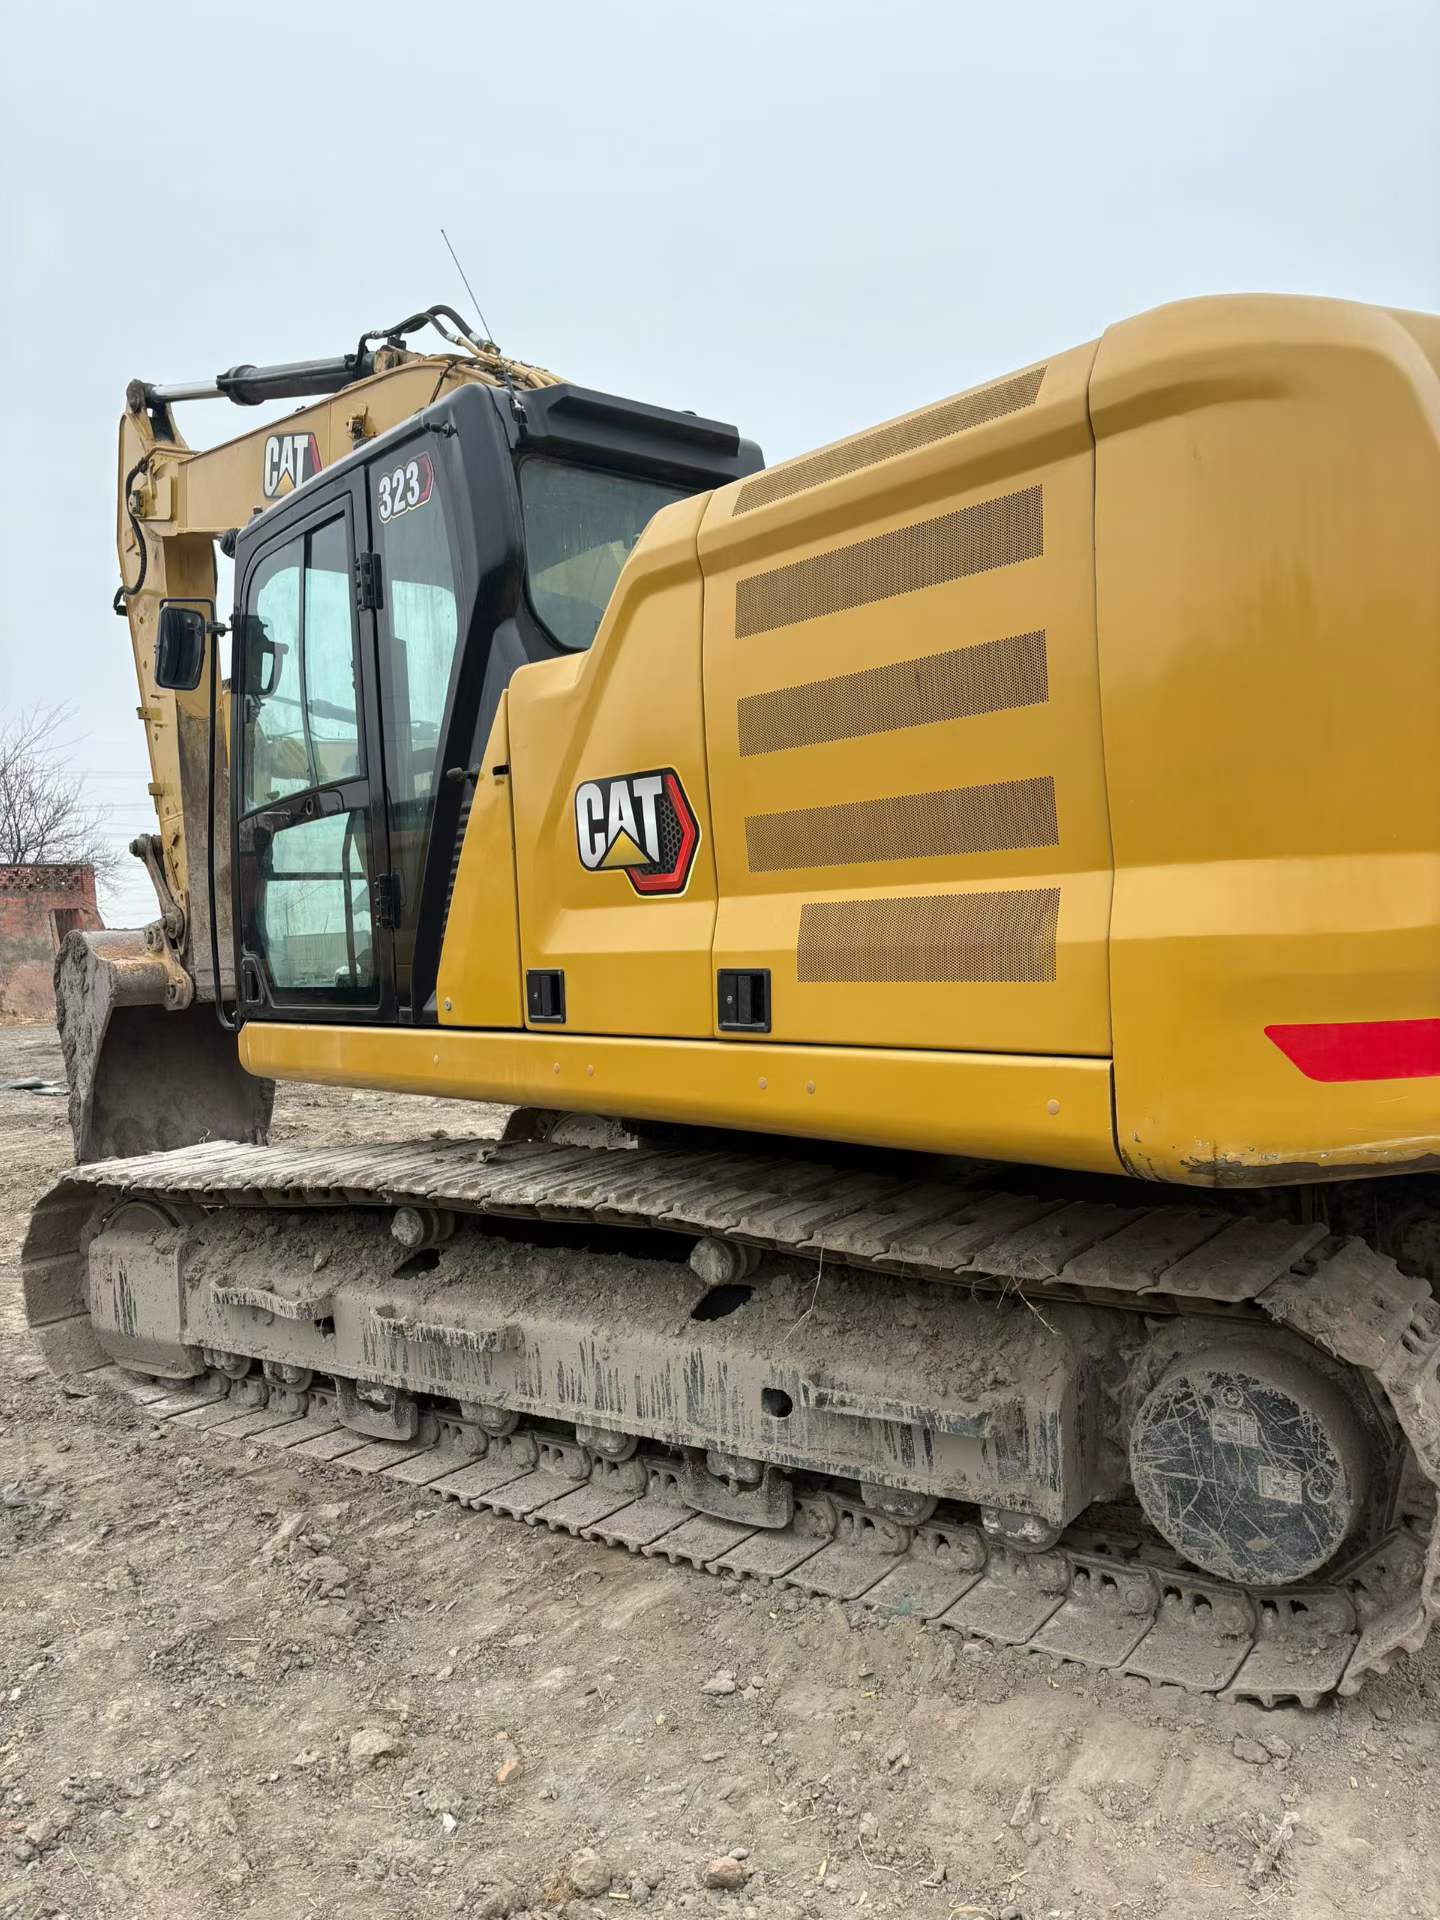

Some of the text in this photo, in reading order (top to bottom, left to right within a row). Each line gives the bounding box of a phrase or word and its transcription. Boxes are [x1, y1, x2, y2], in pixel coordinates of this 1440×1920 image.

[265, 434, 309, 497] CAT
[379, 461, 420, 519] 323
[576, 775, 663, 868] CAT
